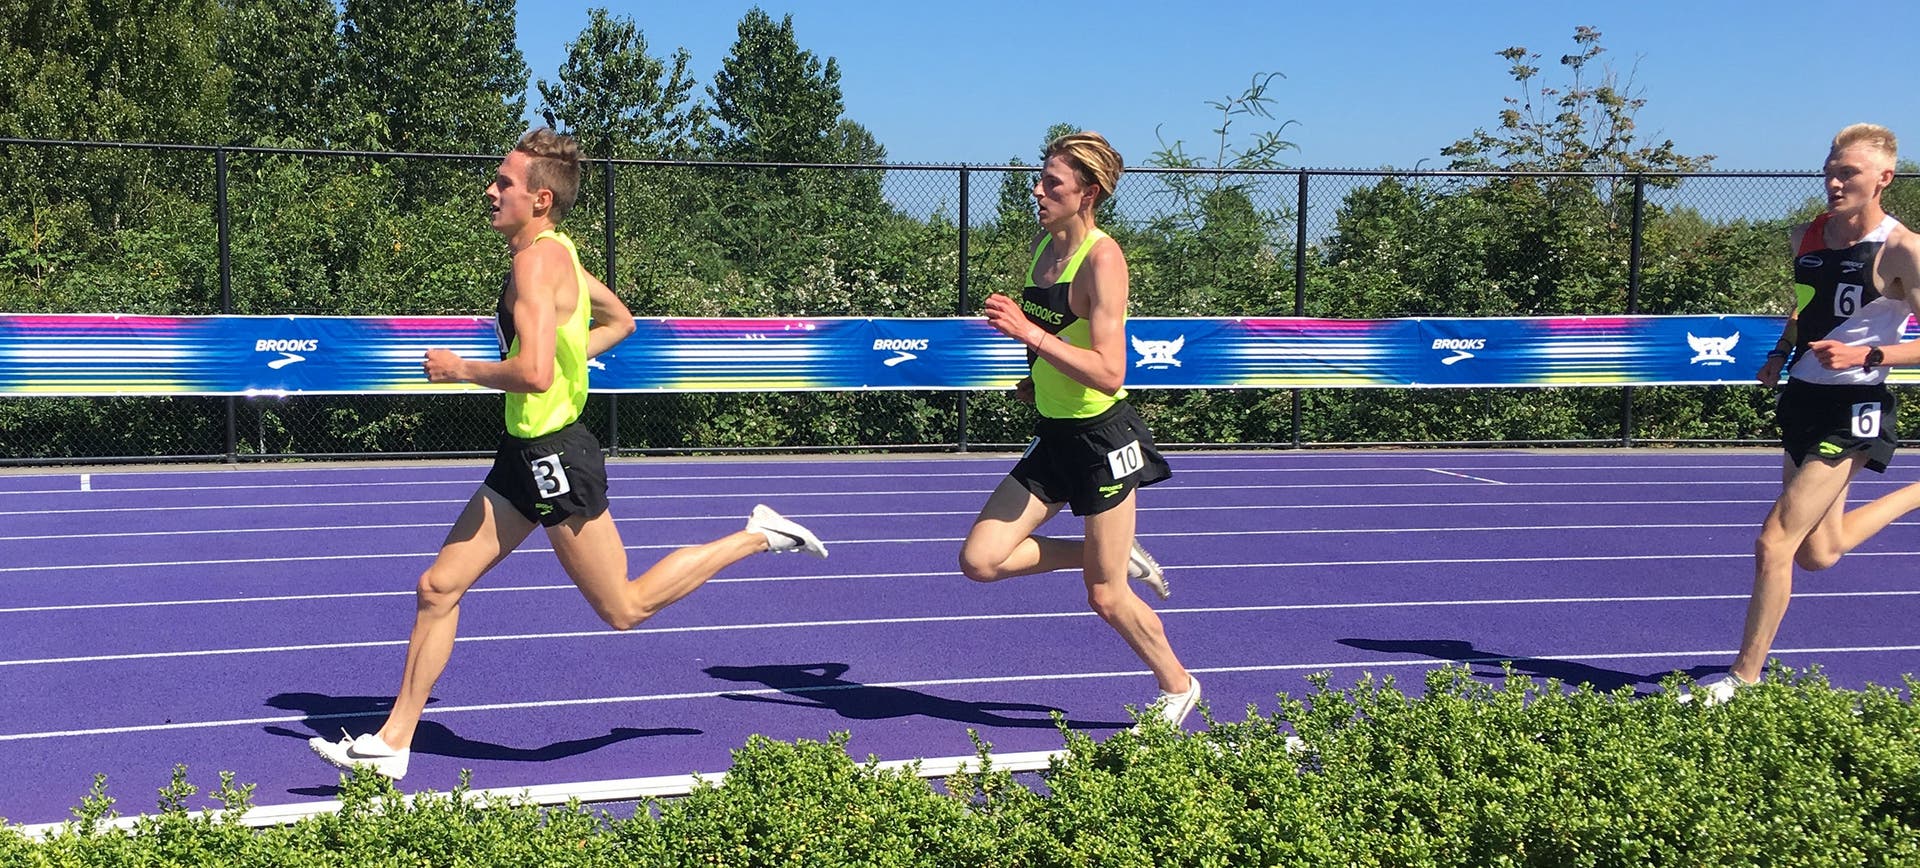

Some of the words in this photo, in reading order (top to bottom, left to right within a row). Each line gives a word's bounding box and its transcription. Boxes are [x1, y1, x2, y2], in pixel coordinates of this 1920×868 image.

[1023, 300, 1064, 325] BROOKS
[1840, 286, 1855, 316] 6
[255, 339, 319, 352] BROOKS
[872, 339, 929, 350] BROOKS
[1431, 338, 1487, 350] BROOKS
[1857, 403, 1874, 435] 6
[1116, 446, 1138, 474] 10
[537, 460, 561, 494] 3
